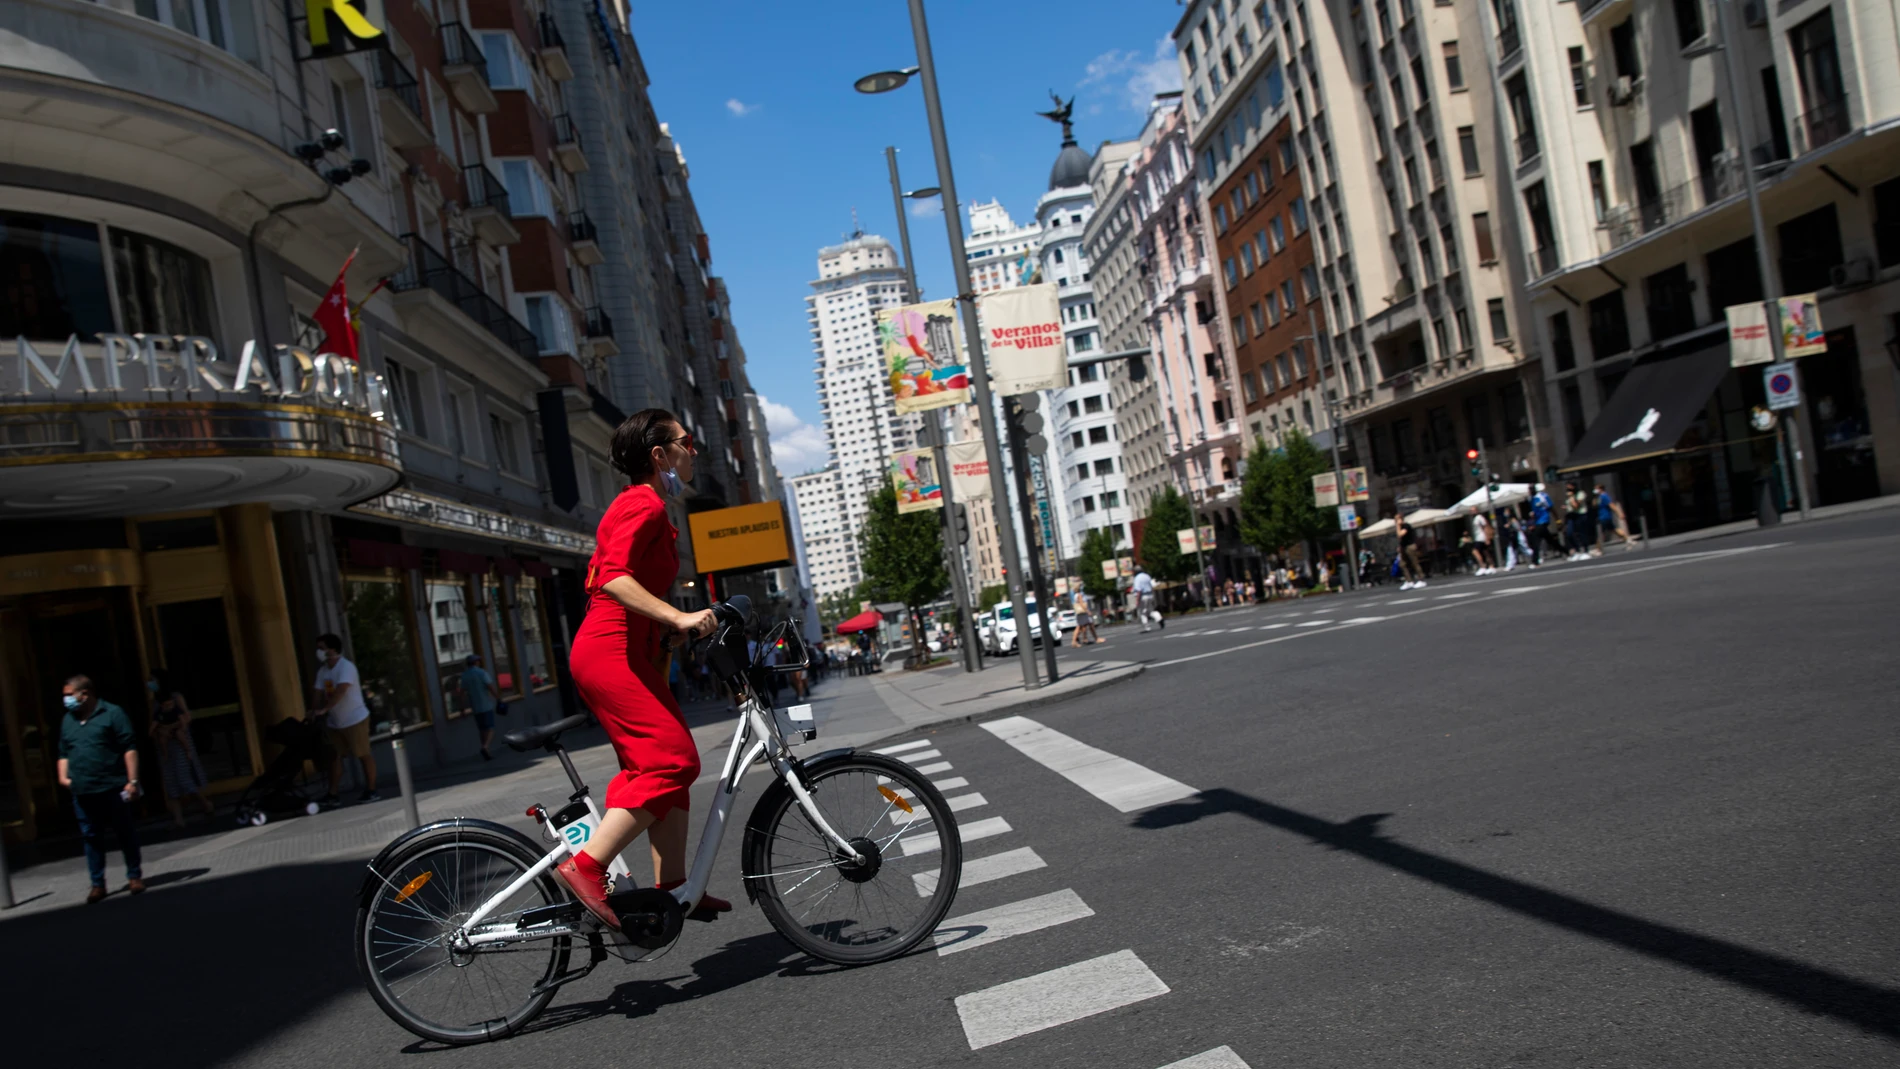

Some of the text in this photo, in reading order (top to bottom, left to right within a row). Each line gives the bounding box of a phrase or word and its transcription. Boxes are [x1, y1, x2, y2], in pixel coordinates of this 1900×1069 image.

[991, 323, 1060, 339] Veranos
[991, 340, 1002, 348] de
[1014, 335, 1053, 350] Villa
[0, 332, 369, 410] MPERADOR
[1024, 380, 1053, 389] MADRID
[953, 461, 989, 470] Verano
[709, 520, 779, 539] NUESTRO APLAUSO ES
[1039, 501, 1053, 548] HOTEL
